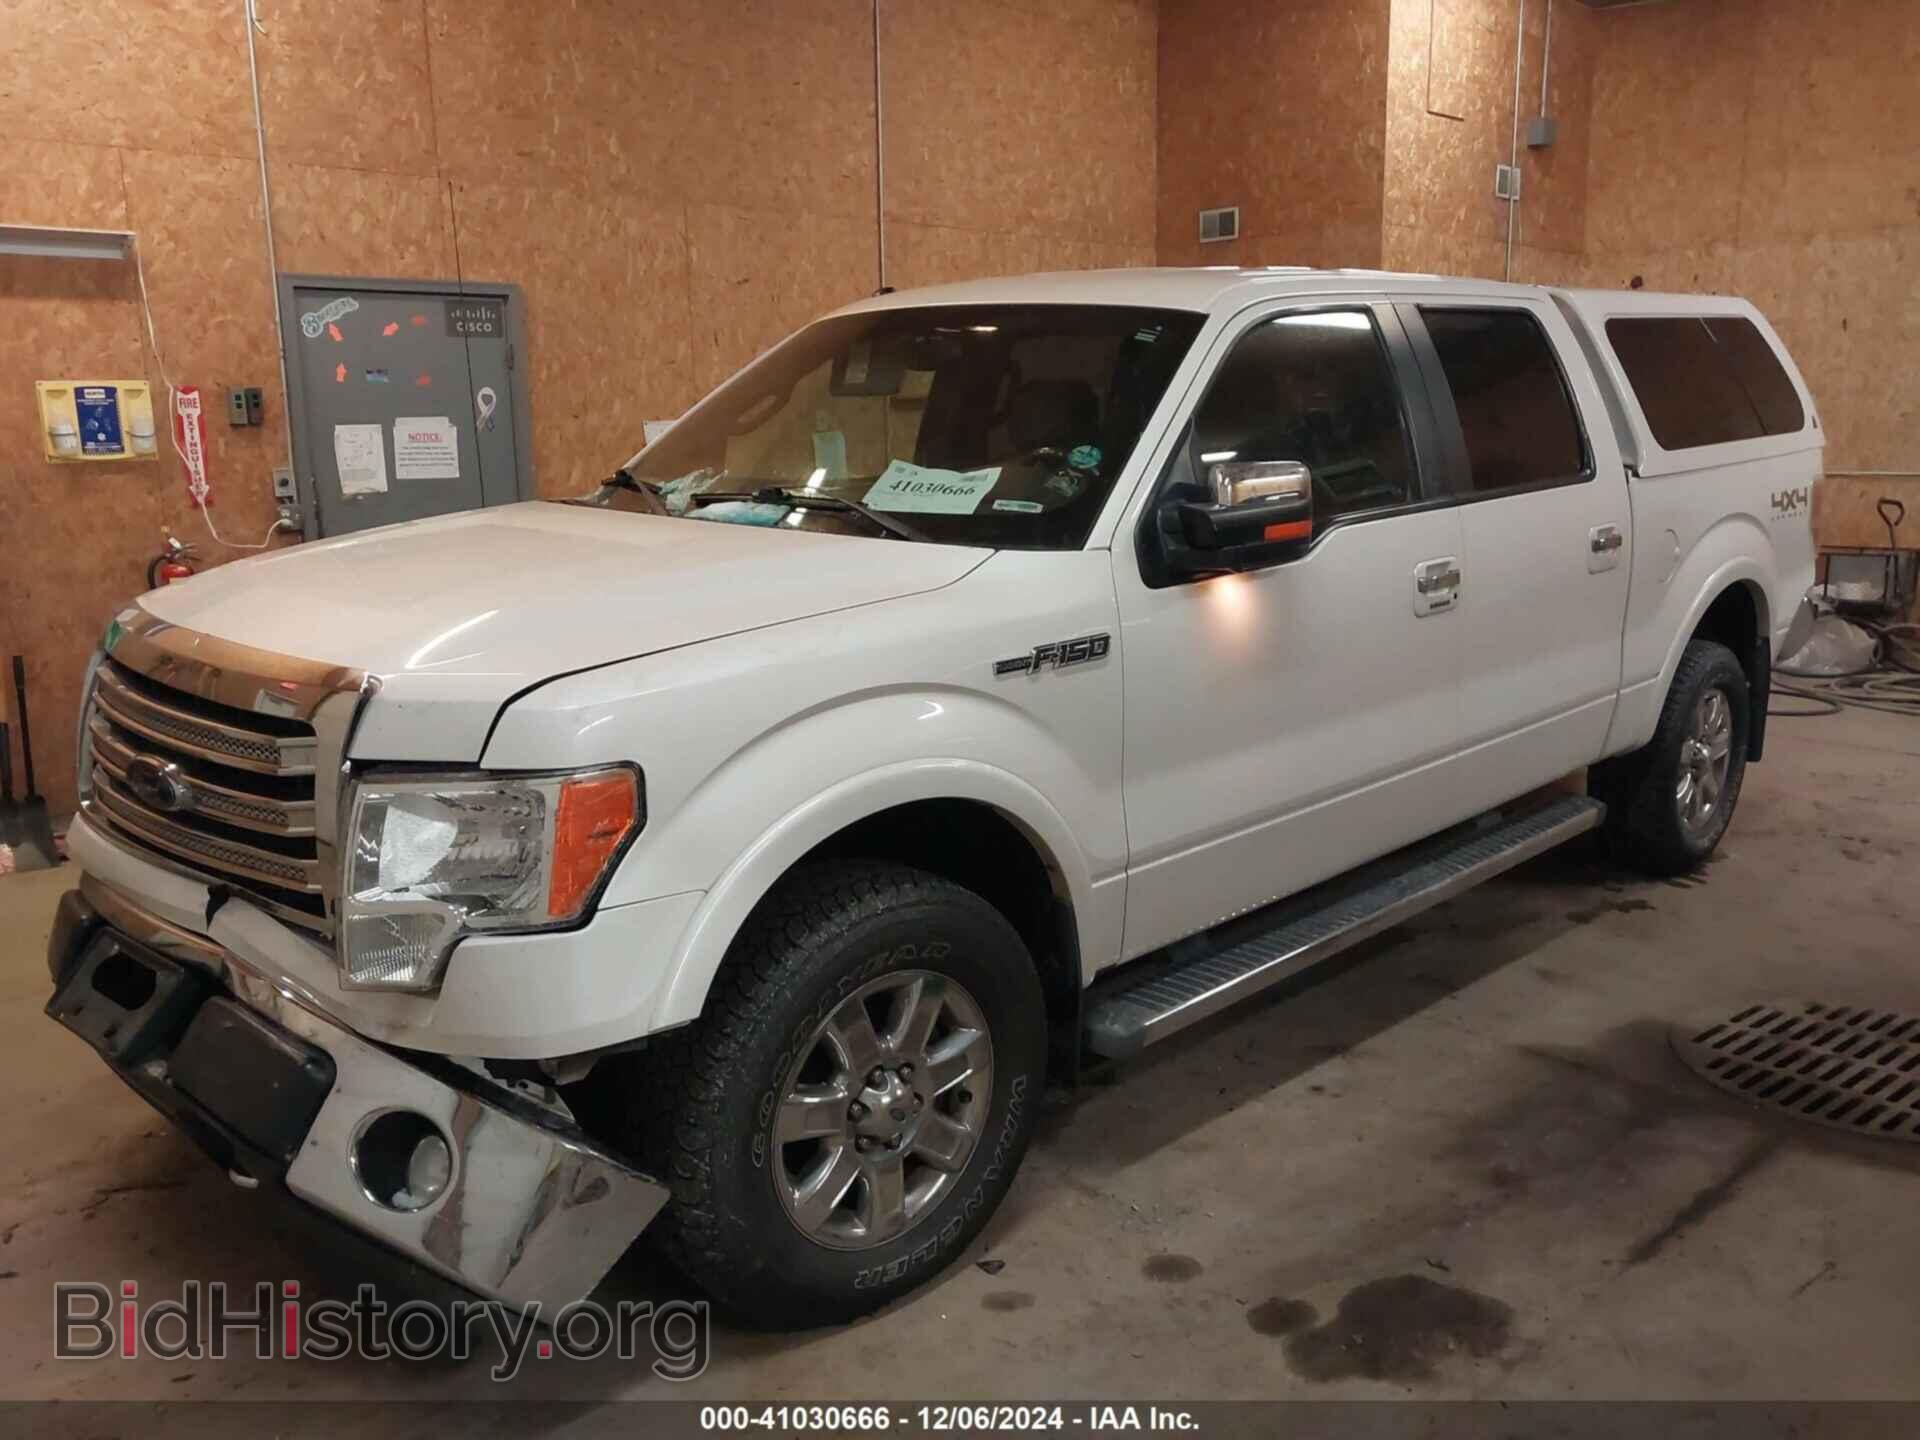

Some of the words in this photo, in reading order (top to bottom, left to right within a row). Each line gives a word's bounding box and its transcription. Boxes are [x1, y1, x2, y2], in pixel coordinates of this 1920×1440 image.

[179, 397, 199, 409] FIRE
[888, 479, 977, 497] 41030666
[854, 1073, 1028, 1289] WRANGLER
